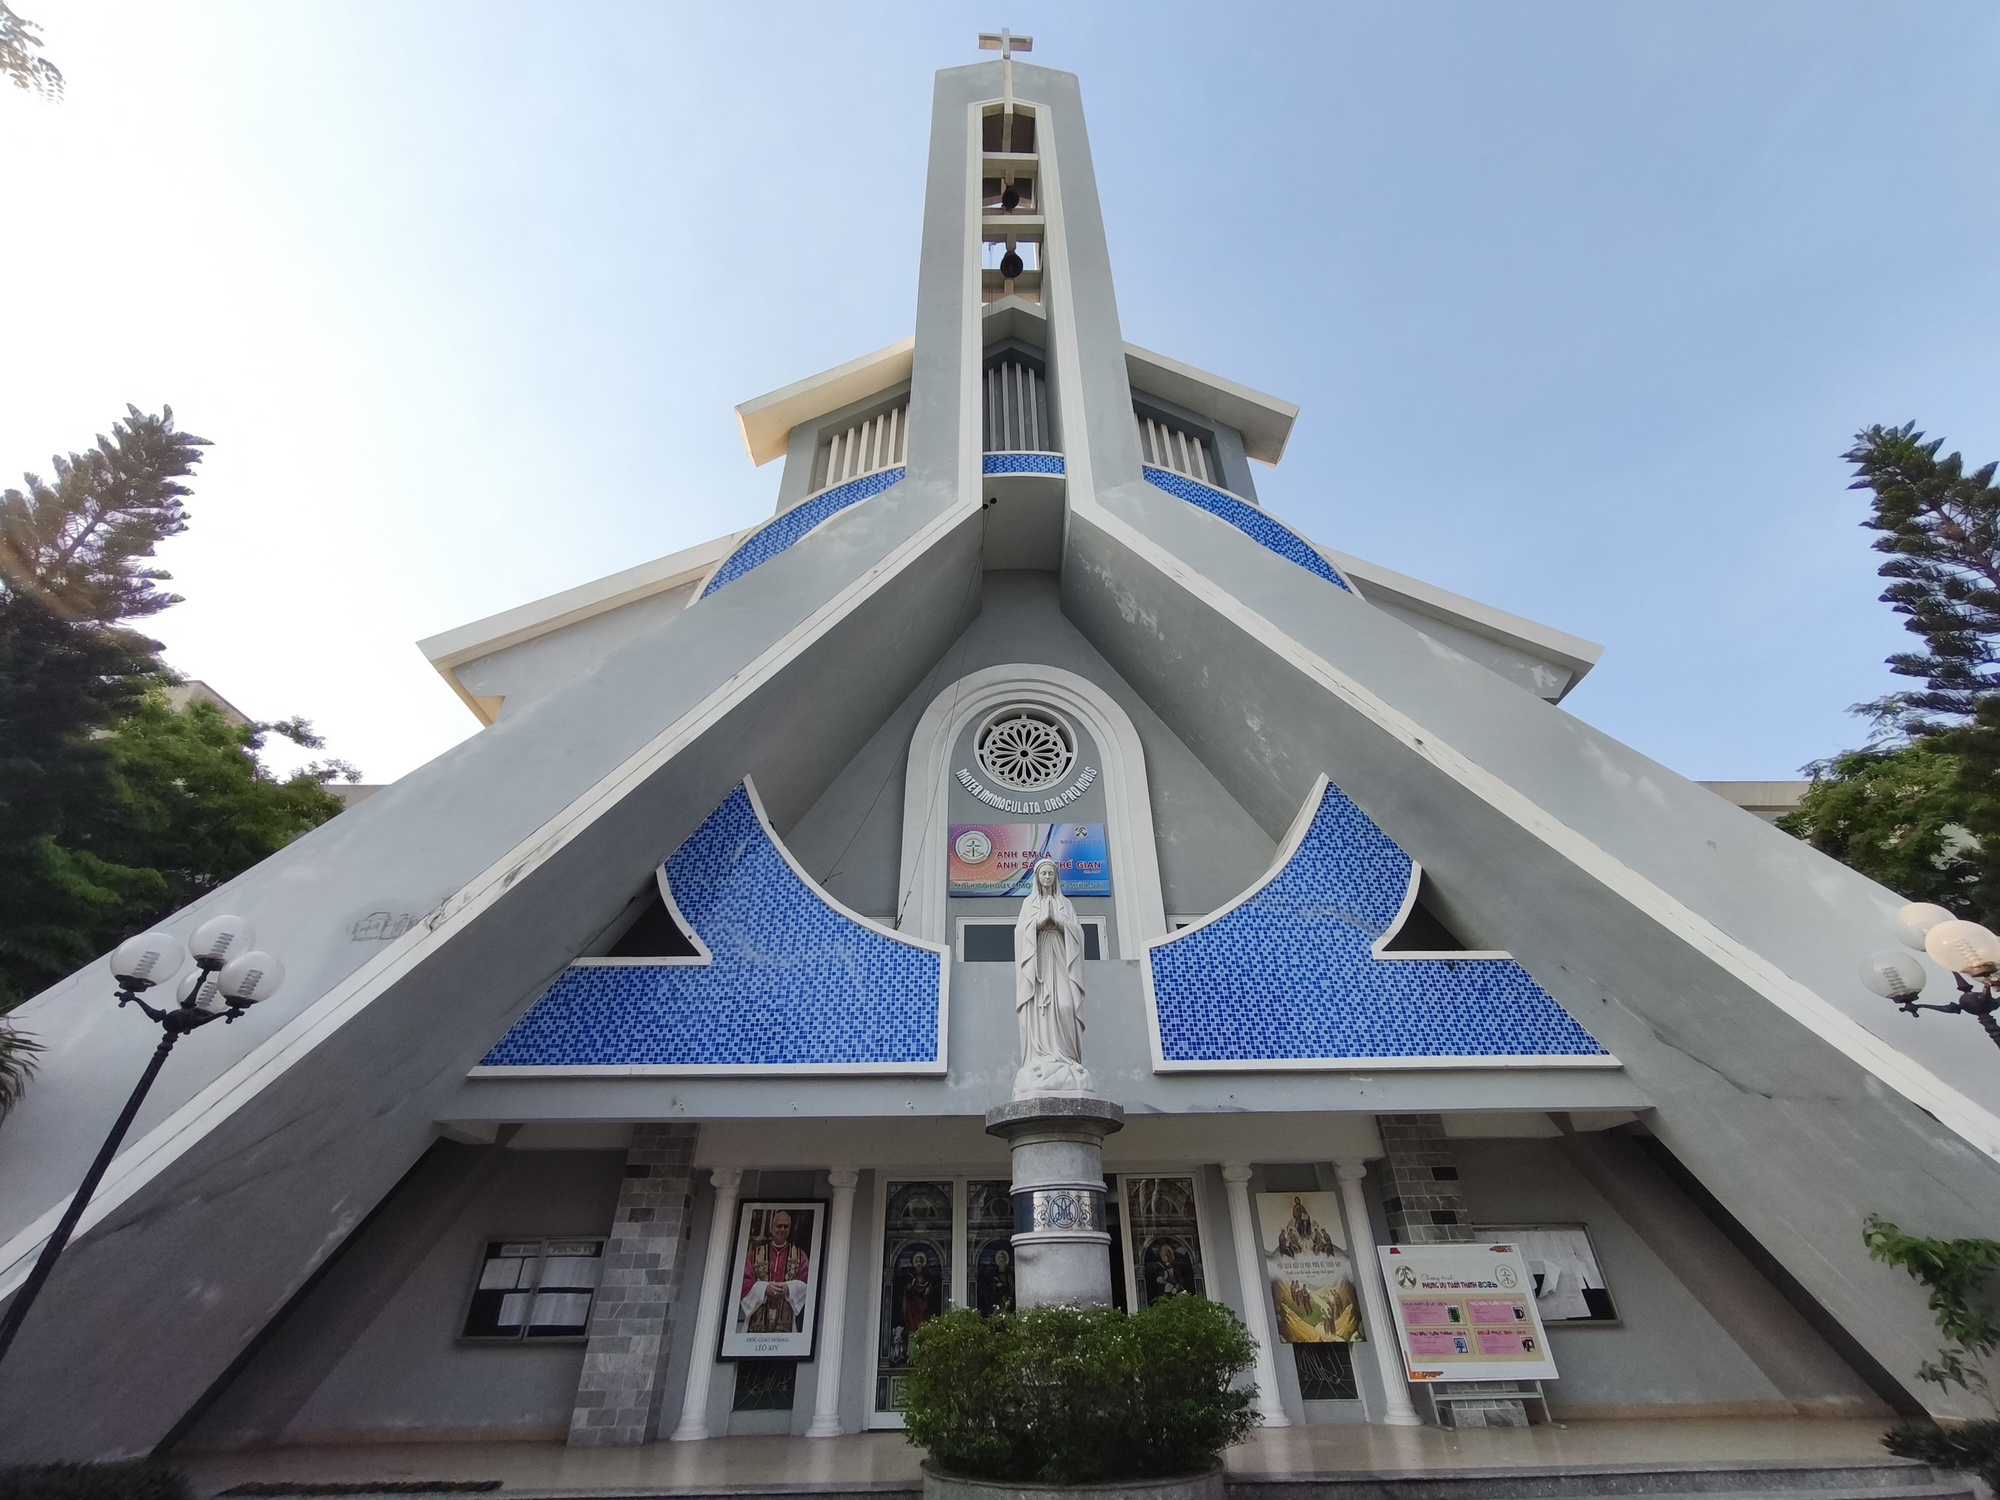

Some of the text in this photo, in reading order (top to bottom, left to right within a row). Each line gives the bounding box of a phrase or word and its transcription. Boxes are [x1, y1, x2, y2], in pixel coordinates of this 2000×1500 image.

[955, 768, 983, 798] MATER
[980, 790, 1041, 814] IMMACULATA
[1061, 785, 1081, 805] PRO
[1075, 766, 1098, 794] NOBIS
[1022, 850, 1037, 860] EM
[1076, 860, 1101, 870] GIAN
